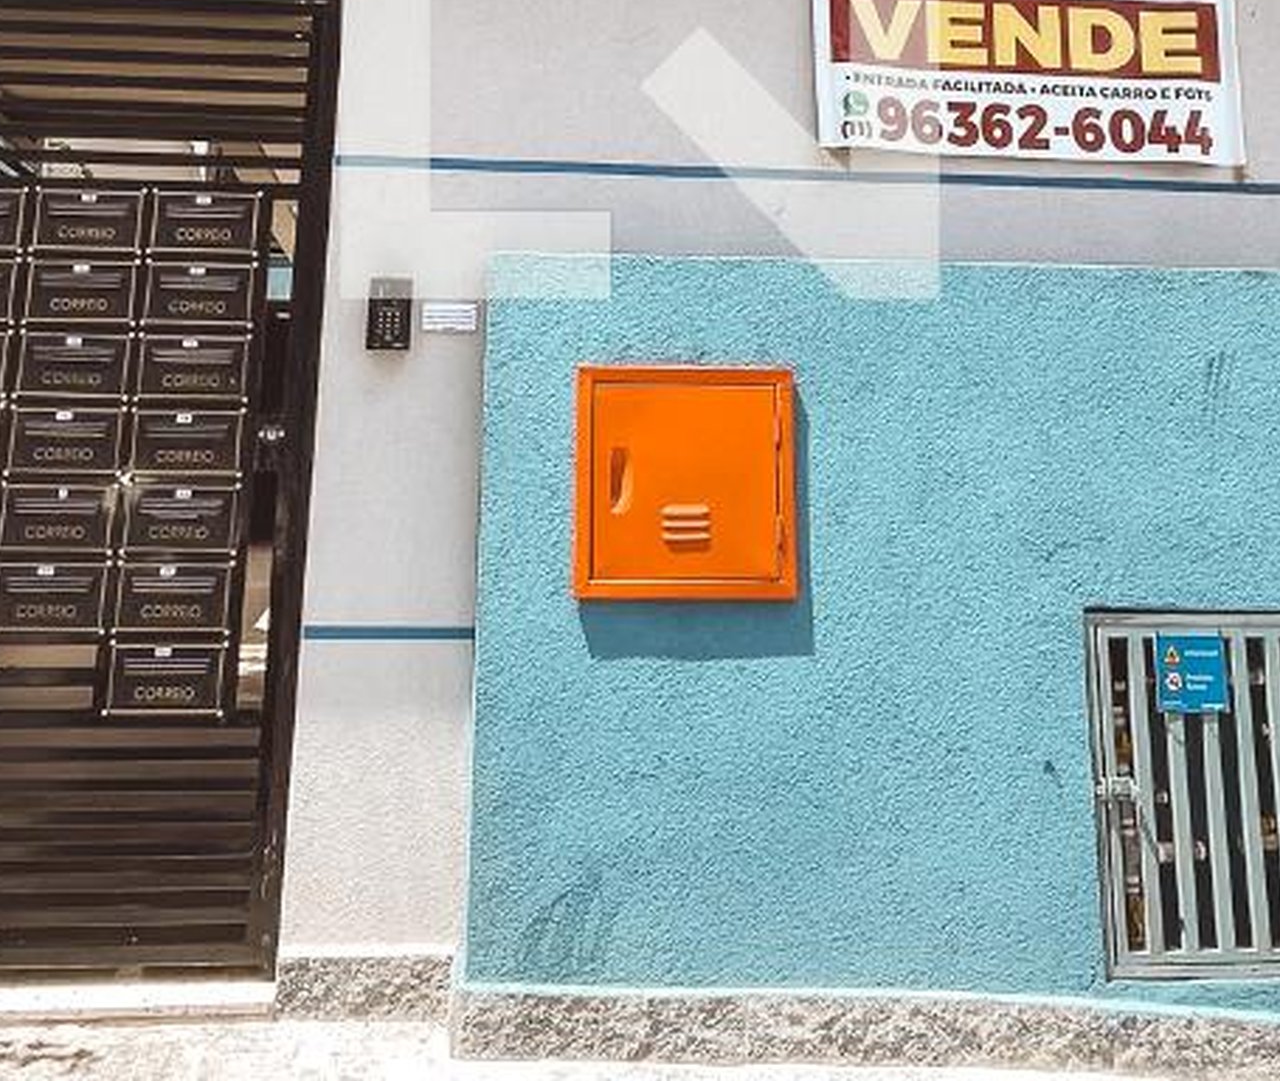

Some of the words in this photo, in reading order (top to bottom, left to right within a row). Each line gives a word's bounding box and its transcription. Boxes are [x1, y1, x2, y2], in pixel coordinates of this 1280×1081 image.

[853, 71, 929, 91] ENTRADA
[932, 78, 1028, 95] FACILITADA
[1039, 83, 1097, 99] ACEITA
[1099, 85, 1158, 100] CARRO
[1161, 87, 1172, 100] E
[1174, 86, 1213, 102] FGTS
[841, 120, 873, 140] (11)
[876, 95, 1213, 156] 96362-6044
[49, 297, 108, 312] CORREIO
[25, 525, 85, 540] CORREIO
[133, 686, 196, 701] CORREIO
